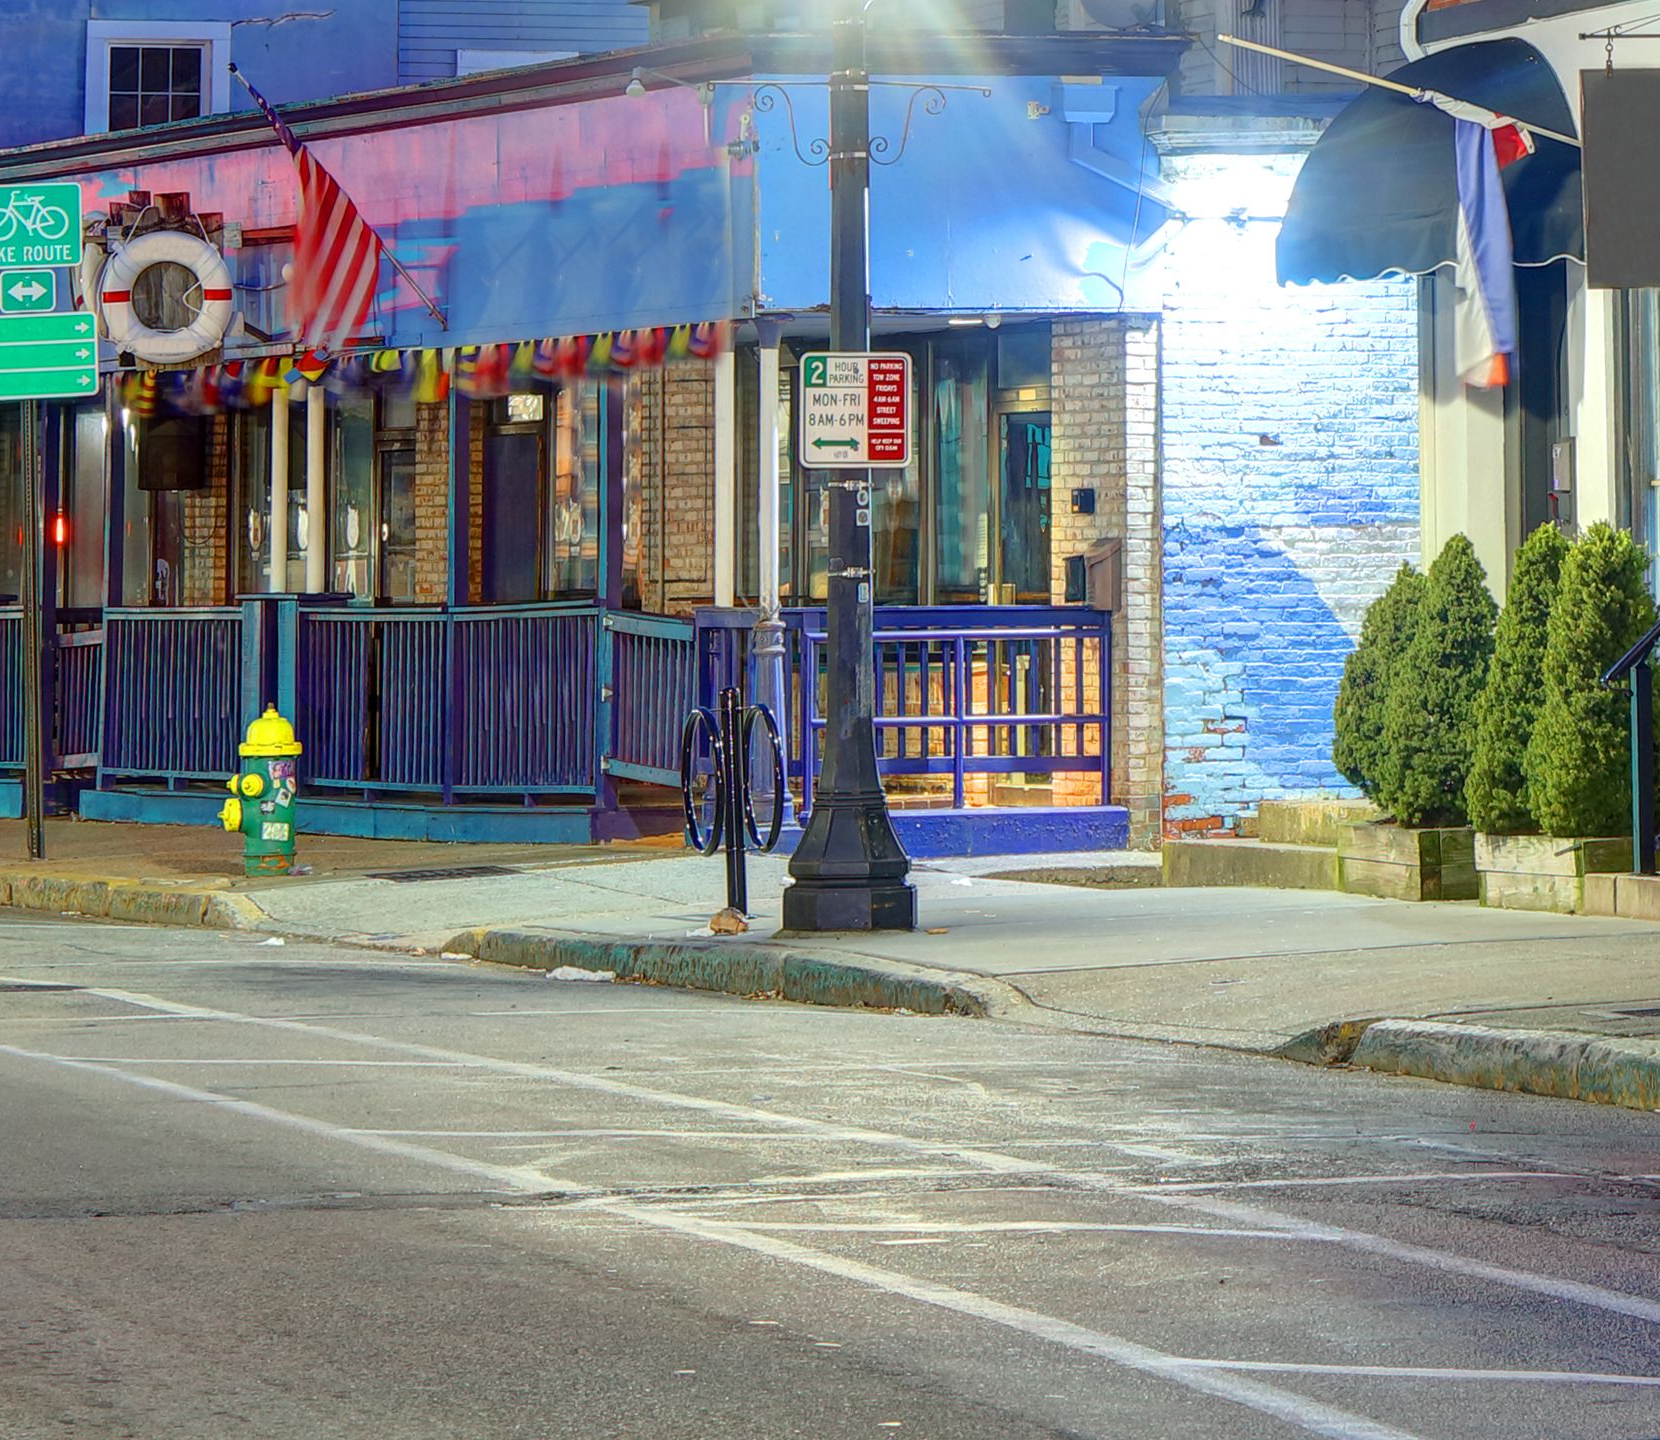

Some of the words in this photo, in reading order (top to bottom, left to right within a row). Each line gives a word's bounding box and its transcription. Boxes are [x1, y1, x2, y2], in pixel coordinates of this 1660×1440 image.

[23, 244, 72, 262] ROUTE
[834, 362, 859, 372] HOUR
[880, 362, 903, 370] PARKING
[810, 361, 824, 384] 2
[885, 373, 900, 381] ZONE
[829, 373, 864, 384] PARKING
[812, 393, 861, 407] MON-FRI
[876, 406, 896, 414] STREET
[872, 417, 900, 425] SWEEPING
